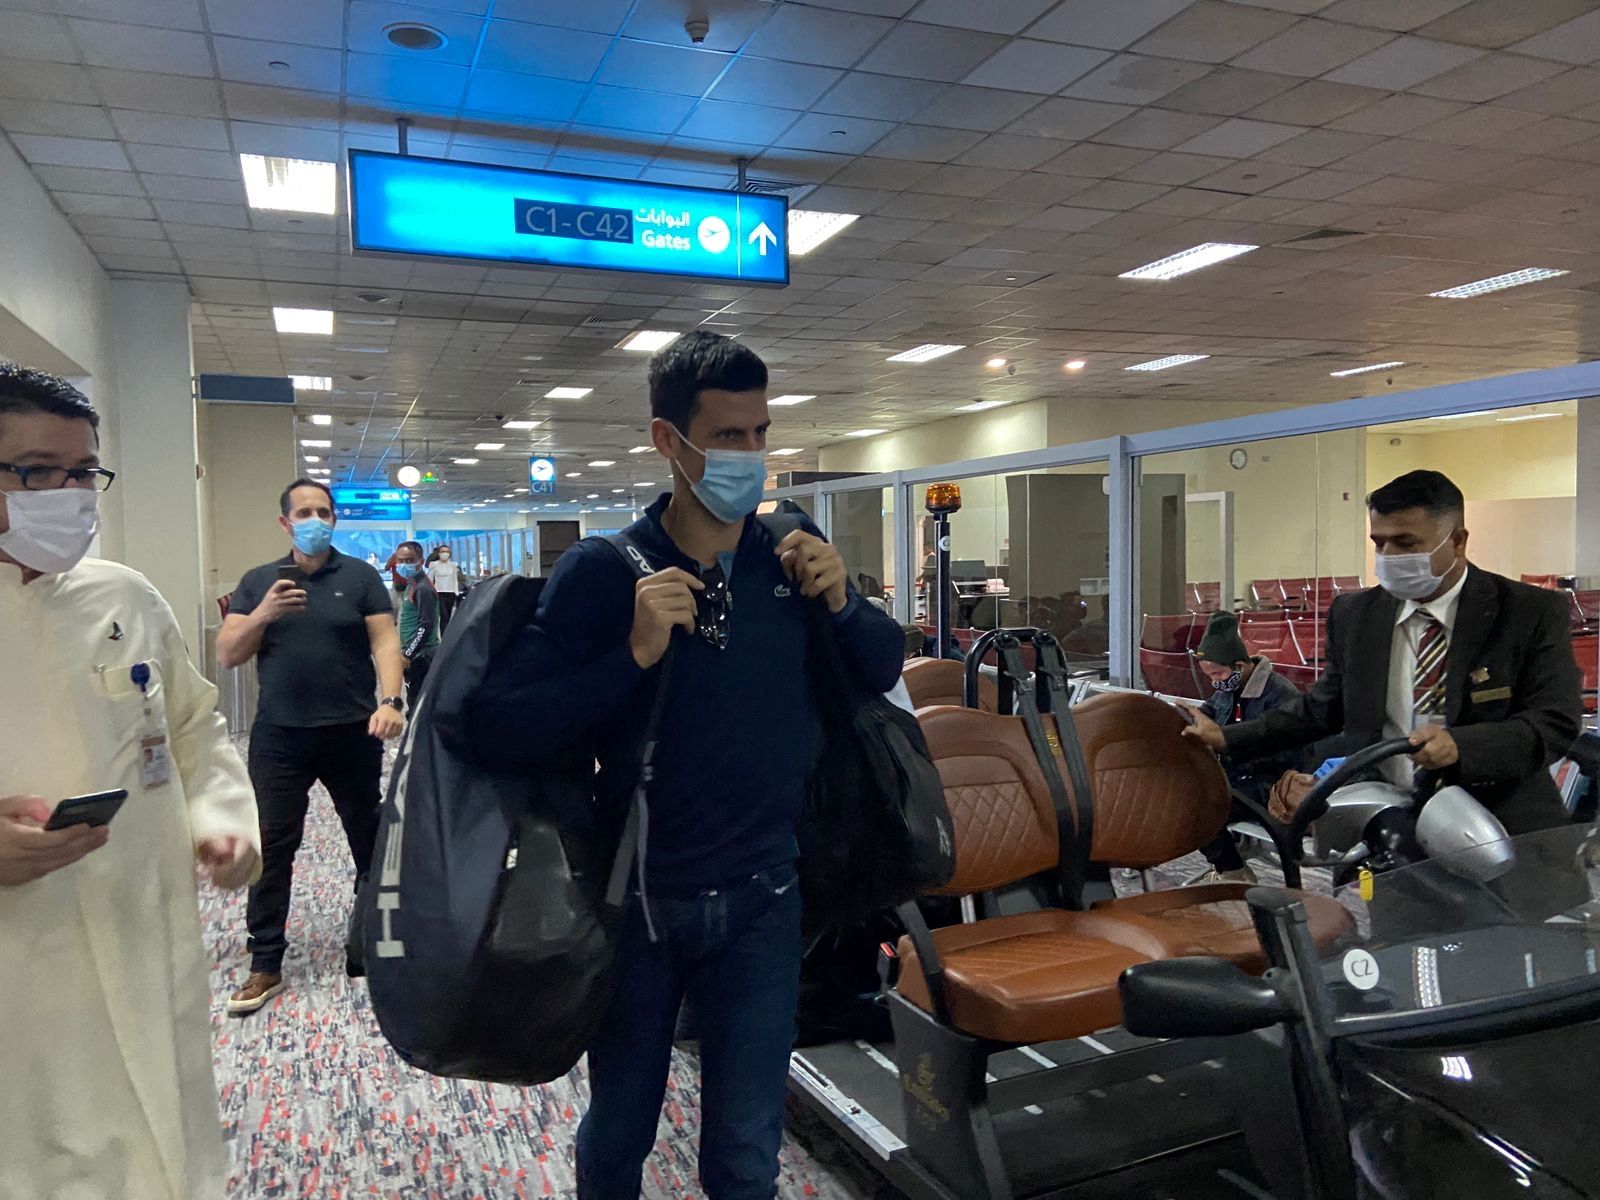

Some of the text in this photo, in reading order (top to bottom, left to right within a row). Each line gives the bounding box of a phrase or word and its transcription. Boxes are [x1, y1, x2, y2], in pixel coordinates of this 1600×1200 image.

[635, 208, 690, 227] البوابات
[641, 230, 691, 251] Gates
[532, 481, 553, 493] C41
[1350, 958, 1374, 977] C2
